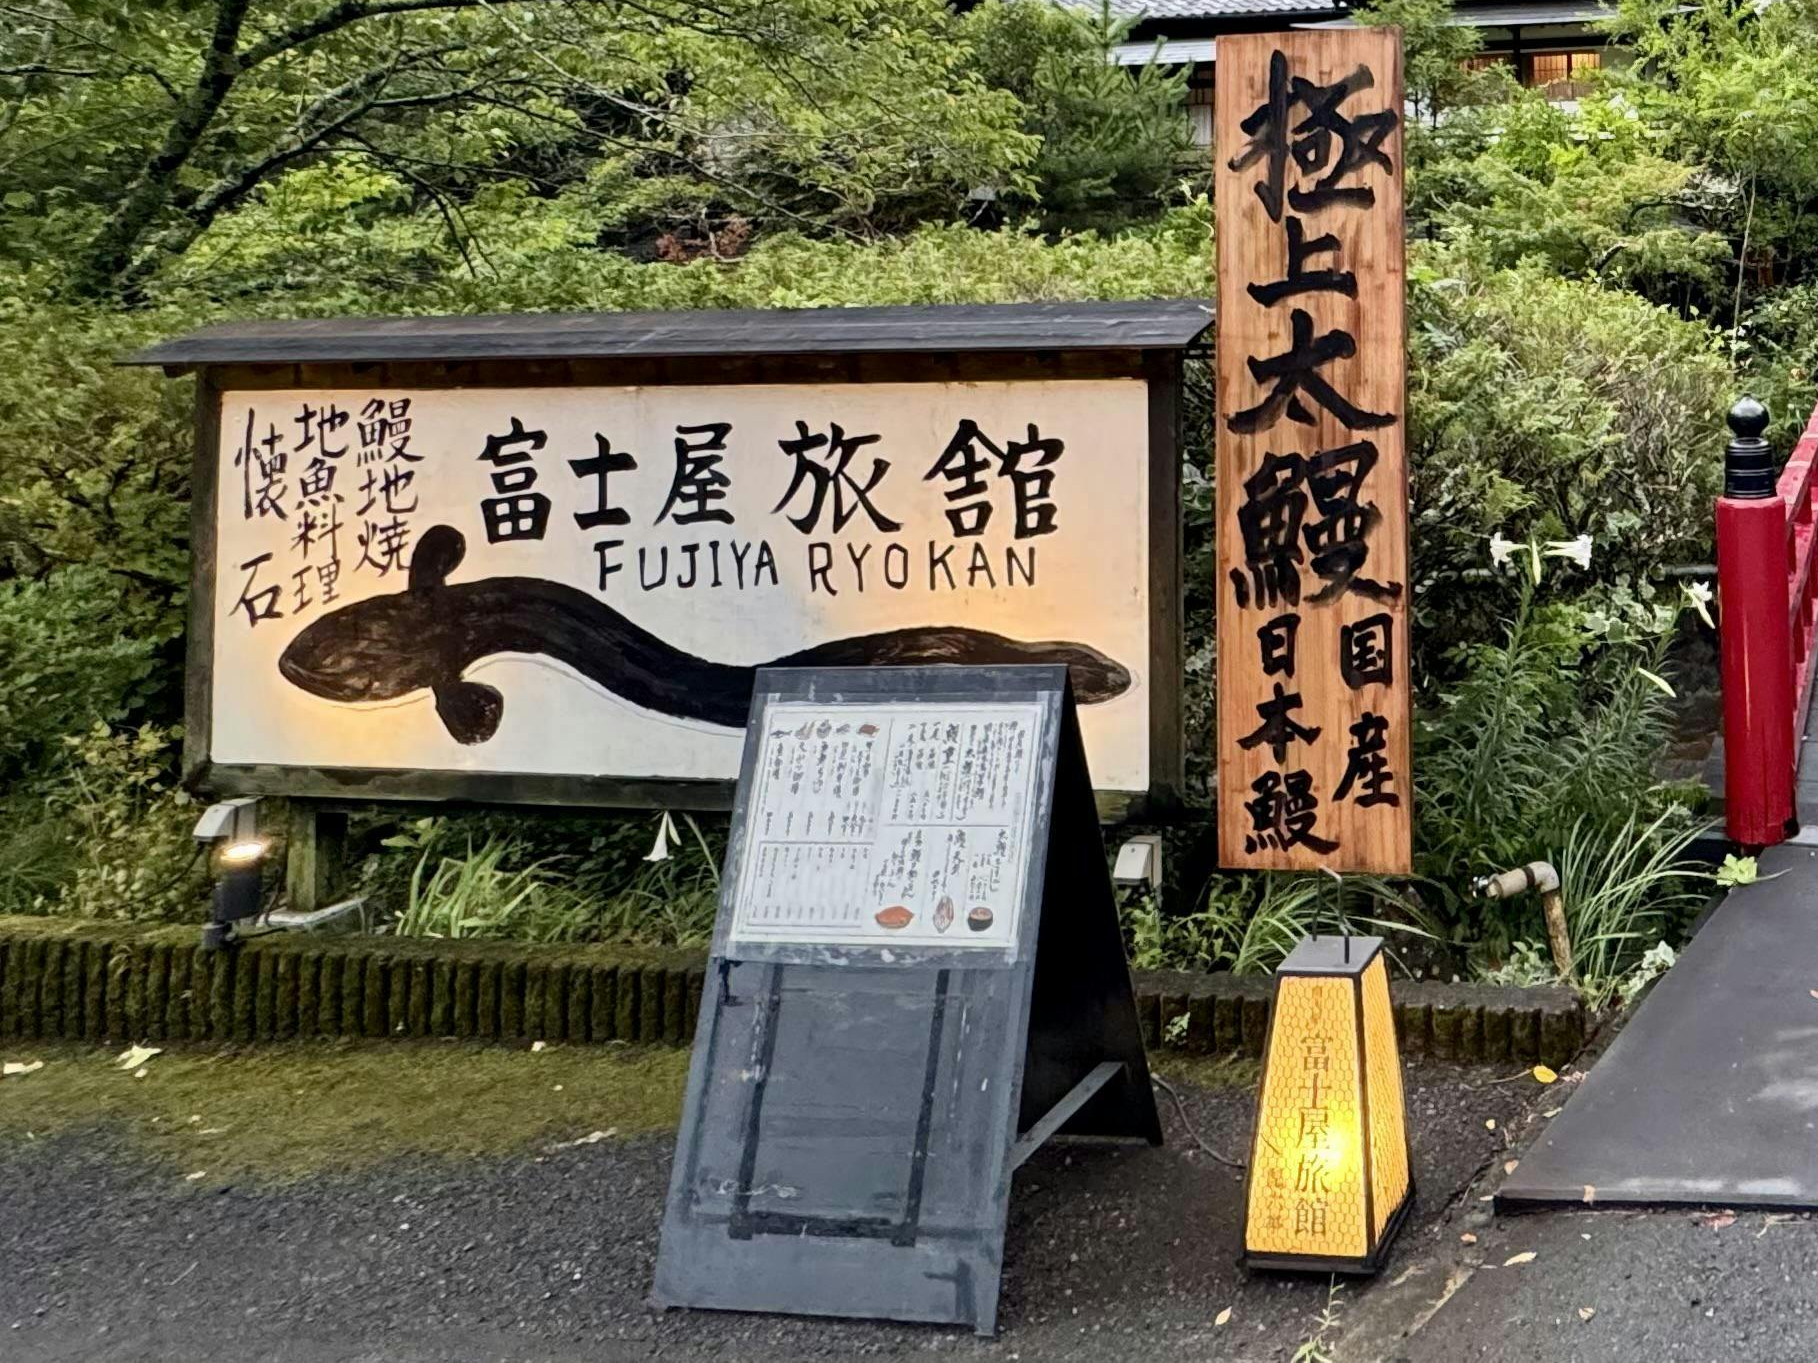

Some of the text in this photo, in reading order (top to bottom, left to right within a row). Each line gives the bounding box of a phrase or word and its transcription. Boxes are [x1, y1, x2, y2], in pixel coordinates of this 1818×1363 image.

[1228, 49, 1403, 610] 極上太鰻
[291, 403, 350, 615] 地魚料理
[594, 539, 1036, 597] FUJIYA RYOKAN
[1236, 613, 1341, 855] 日本鰻
[1332, 613, 1400, 808] 国産
